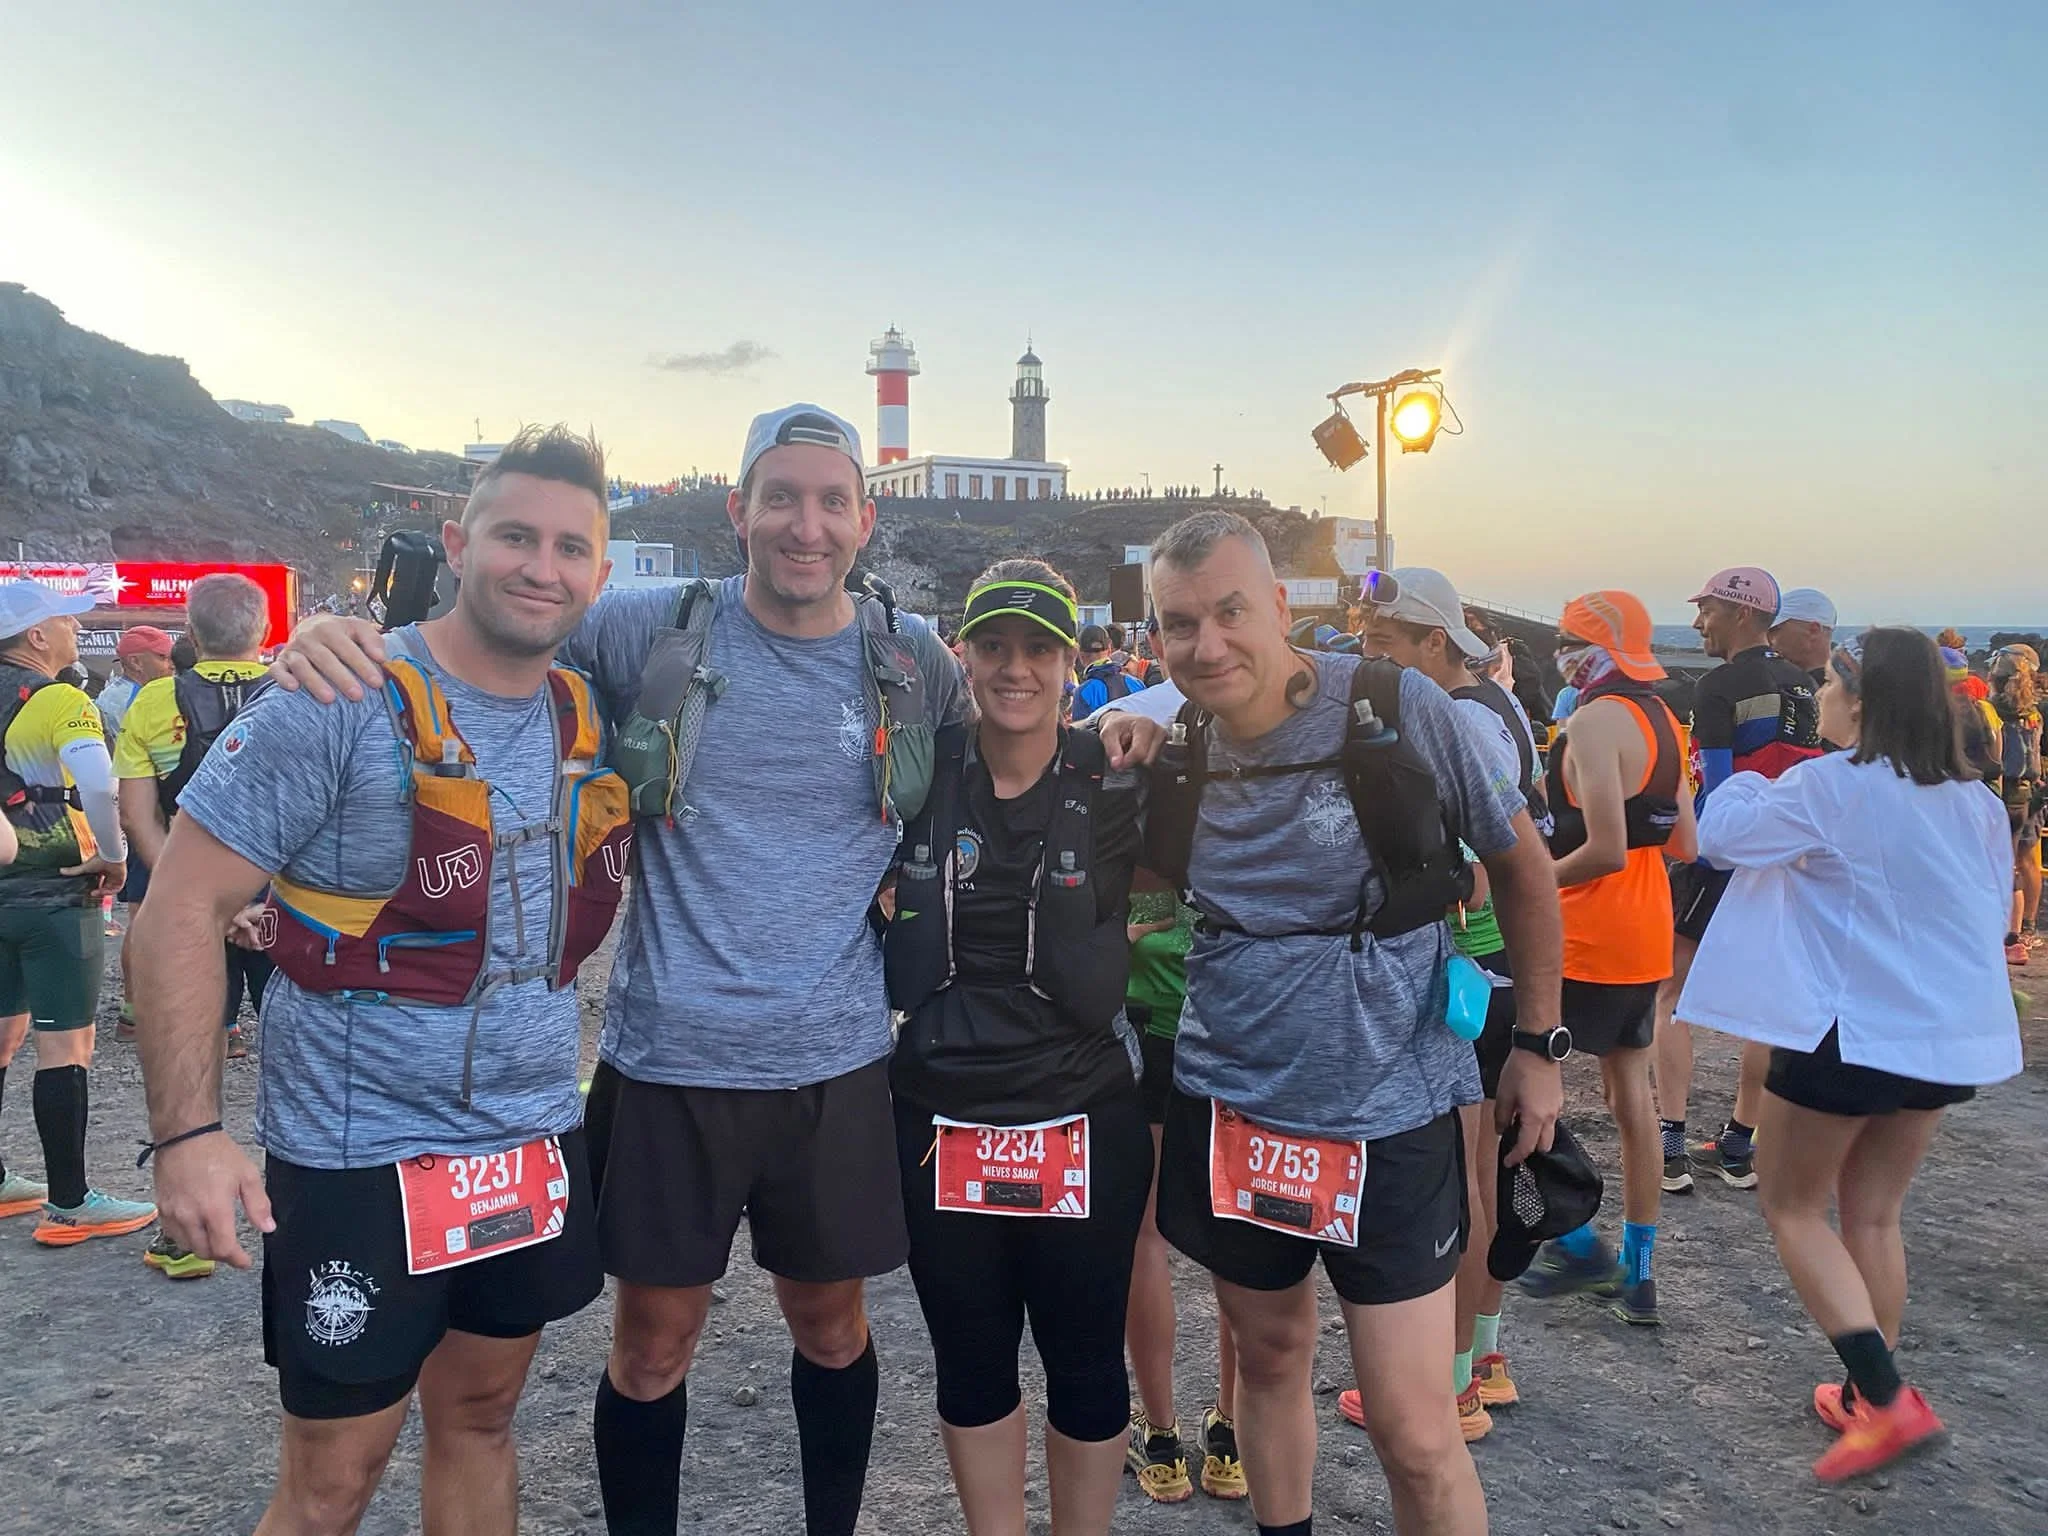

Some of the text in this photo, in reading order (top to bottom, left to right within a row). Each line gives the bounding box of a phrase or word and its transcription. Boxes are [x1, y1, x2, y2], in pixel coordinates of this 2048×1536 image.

[1712, 587, 1761, 605] BROOKLYN
[976, 1127, 1046, 1163] 3234
[1248, 1136, 1320, 1182] 3753
[448, 1147, 523, 1200] 3237
[982, 1165, 1039, 1181] NIEVES SARAY
[1251, 1177, 1312, 1200] JORGE MILLÁN
[470, 1192, 519, 1216] BENJAMIN
